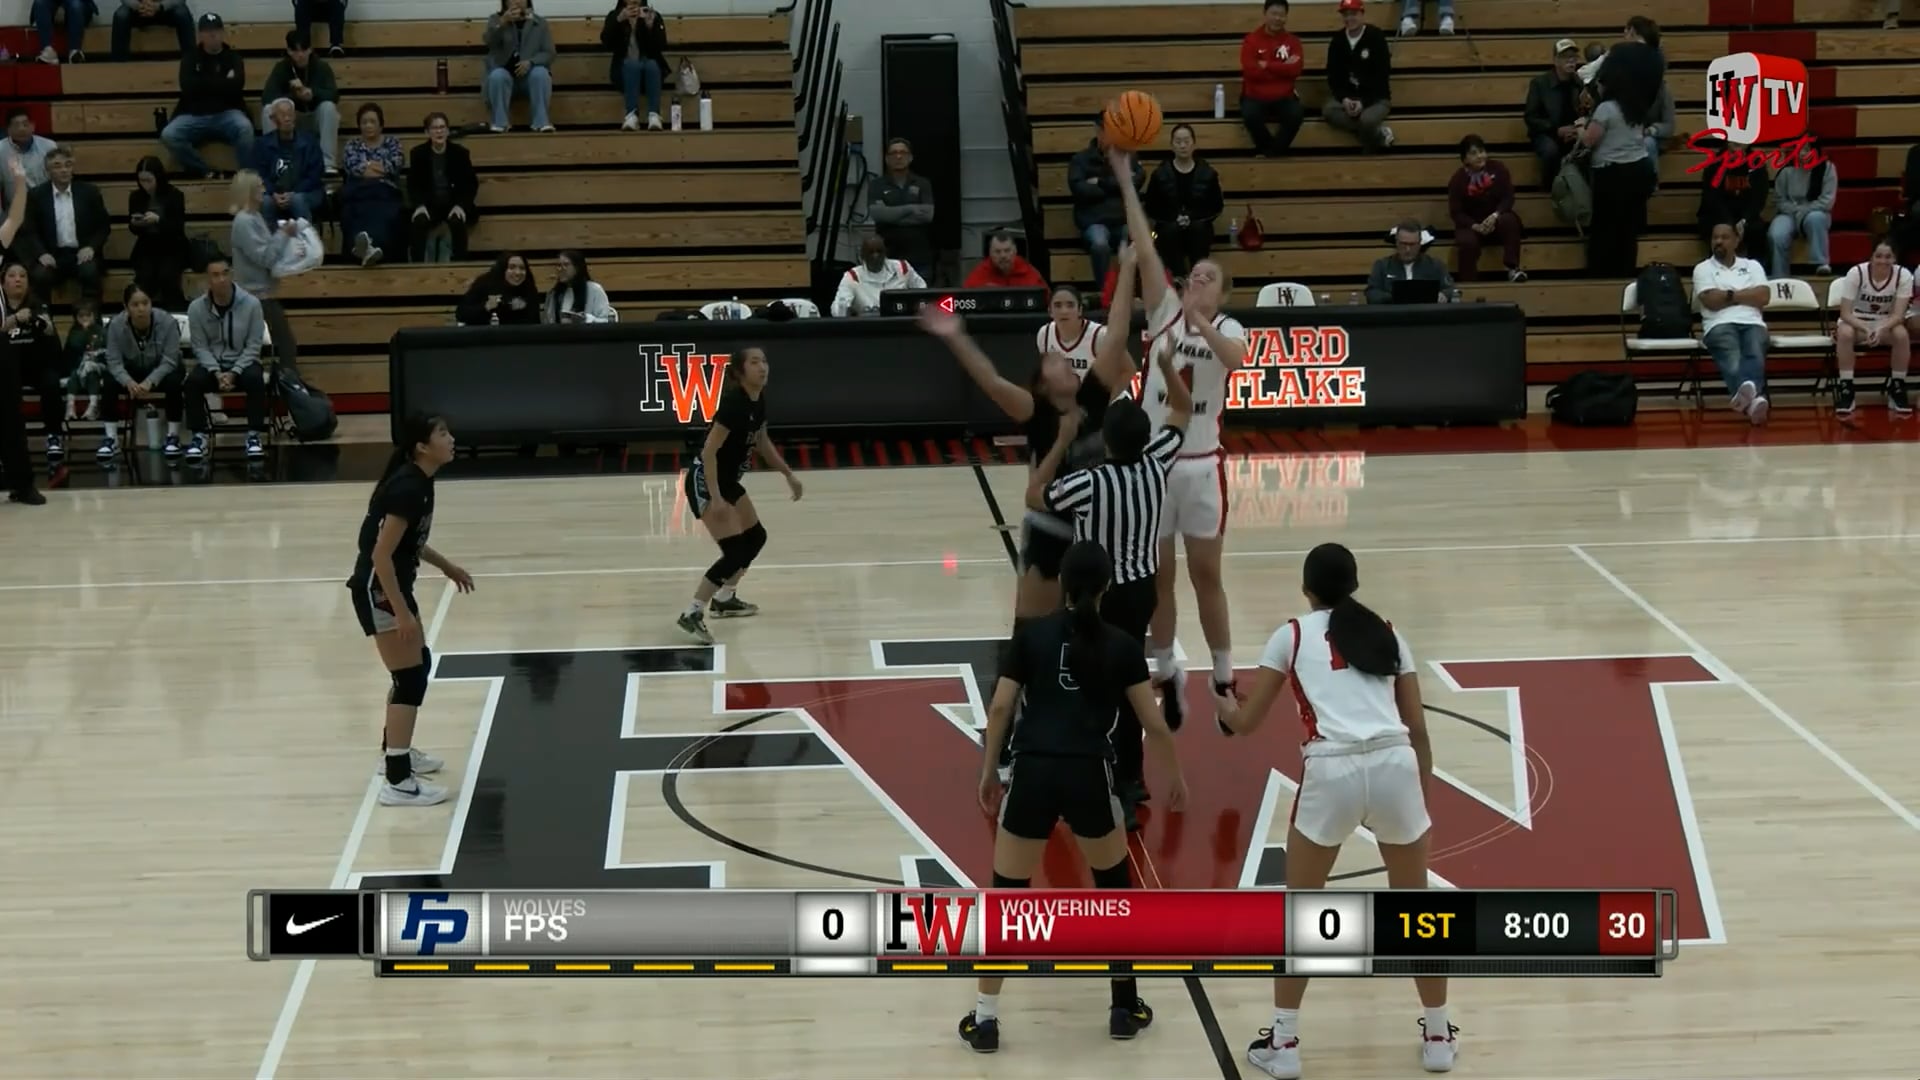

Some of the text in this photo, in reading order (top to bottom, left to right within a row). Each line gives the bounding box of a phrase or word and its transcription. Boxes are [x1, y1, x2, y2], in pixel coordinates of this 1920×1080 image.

[953, 299, 976, 310] POSS
[1243, 326, 1350, 367] VARD
[639, 343, 732, 423] HW
[1226, 366, 1366, 409] TLAKE
